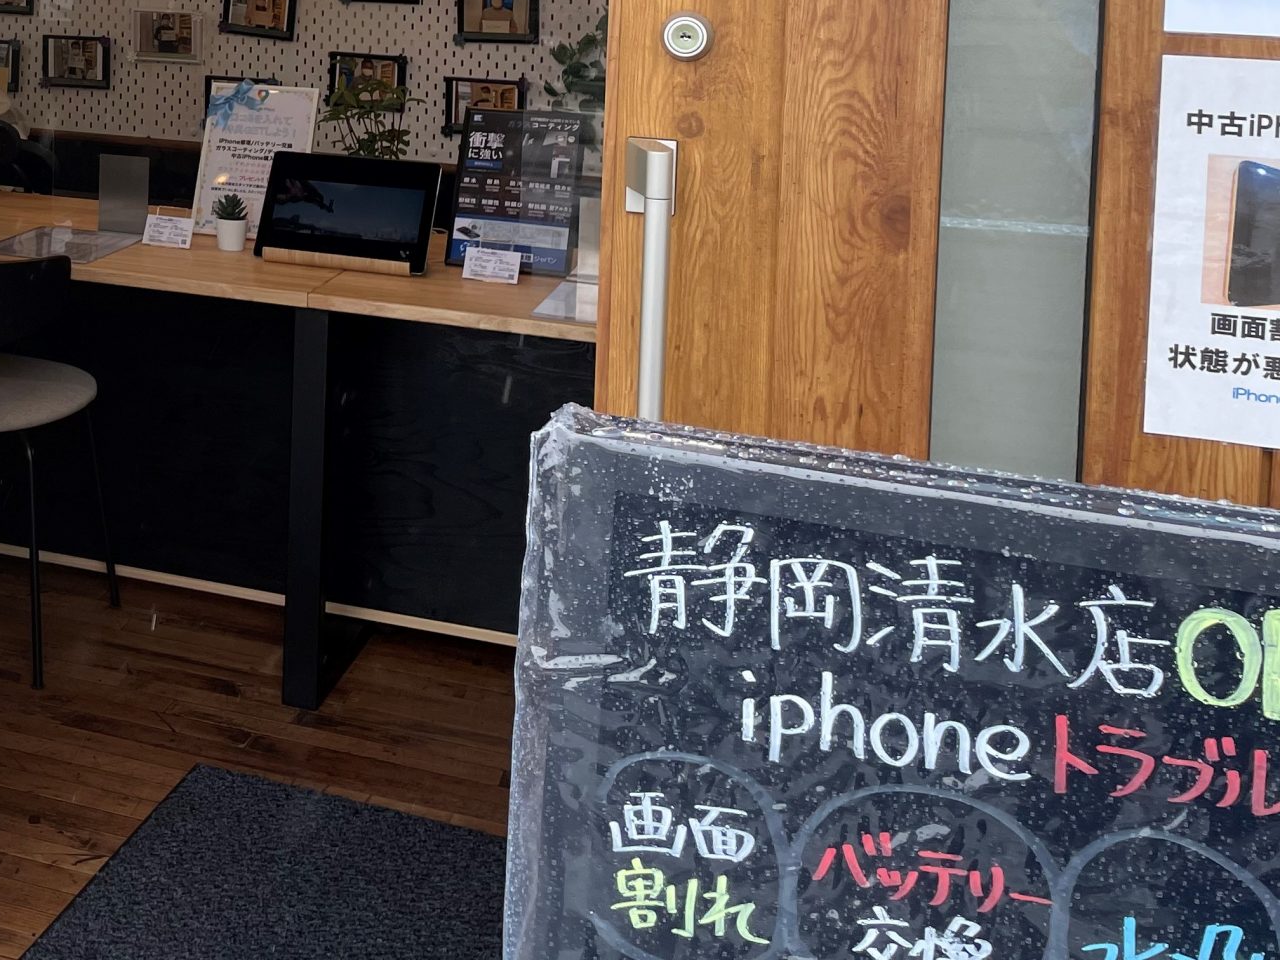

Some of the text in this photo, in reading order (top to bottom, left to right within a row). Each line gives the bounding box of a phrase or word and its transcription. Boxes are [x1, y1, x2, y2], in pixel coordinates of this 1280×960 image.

[624, 520, 1171, 698] 静岡清水店
[740, 670, 1031, 782] iphone
[611, 792, 755, 862] 画面
[611, 860, 770, 945] 割れ
[812, 831, 1055, 913] バッテリー
